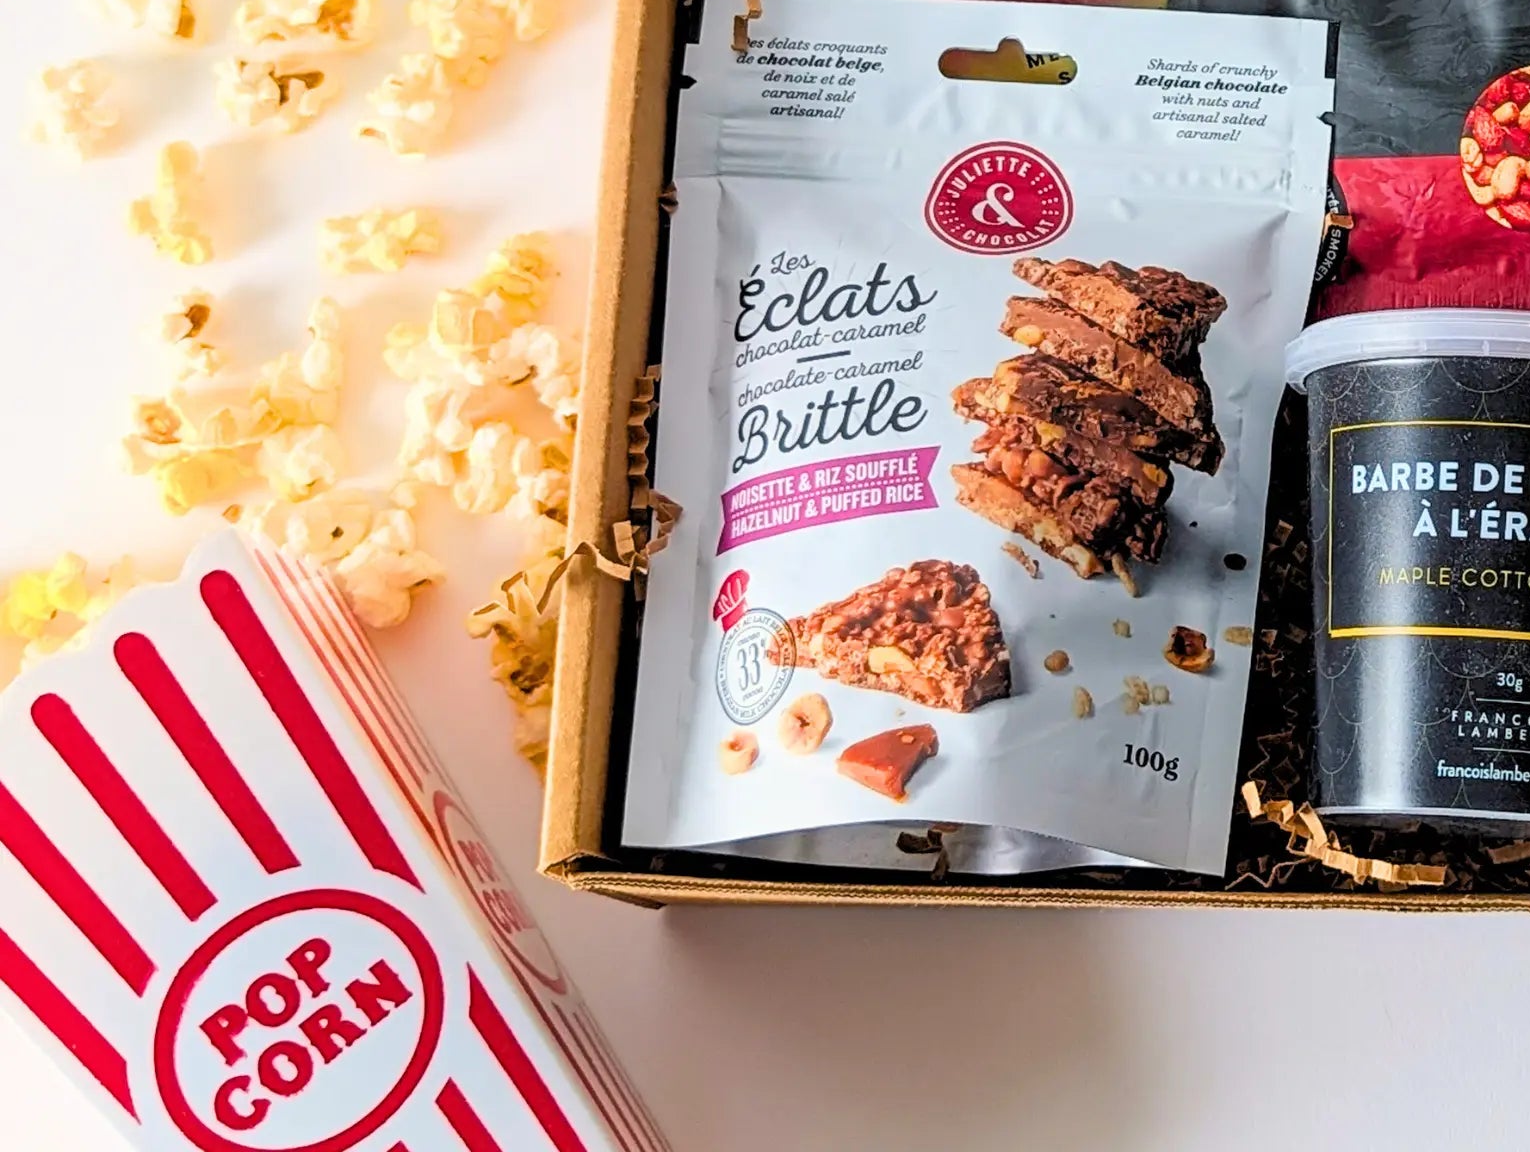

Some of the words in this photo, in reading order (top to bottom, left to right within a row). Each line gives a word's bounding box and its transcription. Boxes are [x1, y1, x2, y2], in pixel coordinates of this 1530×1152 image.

[744, 37, 765, 49] es
[767, 37, 810, 51] éclats
[813, 41, 888, 56] croquants
[736, 53, 755, 65] de
[757, 53, 832, 68] chocolat
[835, 56, 885, 74] belge,
[1147, 58, 1198, 73] Shards
[1201, 62, 1220, 74] of
[1219, 65, 1278, 81] crunchy
[763, 70, 780, 83] de
[784, 72, 818, 84] noix
[820, 73, 834, 85] et
[838, 74, 856, 86] de
[1134, 74, 1201, 91] Belgian
[1204, 78, 1288, 95] chocolate
[761, 88, 824, 101] caramel
[825, 91, 857, 103] salé
[1162, 92, 1194, 106] with
[1197, 97, 1230, 108] nuts
[1232, 98, 1262, 110] and
[770, 105, 845, 119] artisanal!
[1152, 110, 1220, 124] artisanal
[1221, 113, 1268, 127] salted
[1176, 129, 1242, 142] caramel!
[947, 156, 1032, 199] JULIETTE
[972, 182, 1026, 228] &
[962, 219, 1055, 246] CHOCOLAT
[770, 250, 816, 275] Les
[734, 262, 938, 342] Éclats
[736, 313, 927, 368] chocolat-caramel
[738, 350, 924, 407] chocolate-caramel
[732, 378, 929, 474] Brittle
[730, 476, 795, 513] NOISETTE
[798, 472, 812, 492] &
[815, 466, 841, 488] RIZ
[845, 452, 918, 483] SOUFFLÉ
[1352, 461, 1458, 494] BARBE
[1472, 462, 1526, 495] DE
[731, 502, 802, 539] HAZELNUT
[804, 499, 819, 519] &
[821, 487, 881, 515] PUFFED
[885, 482, 924, 504] RICE
[1412, 498, 1438, 537] À
[1378, 566, 1451, 587] MAPLE
[1497, 672, 1523, 693] 30g
[1122, 741, 1180, 782] 100g
[198, 936, 332, 1067] POP
[213, 958, 414, 1131] CORN
